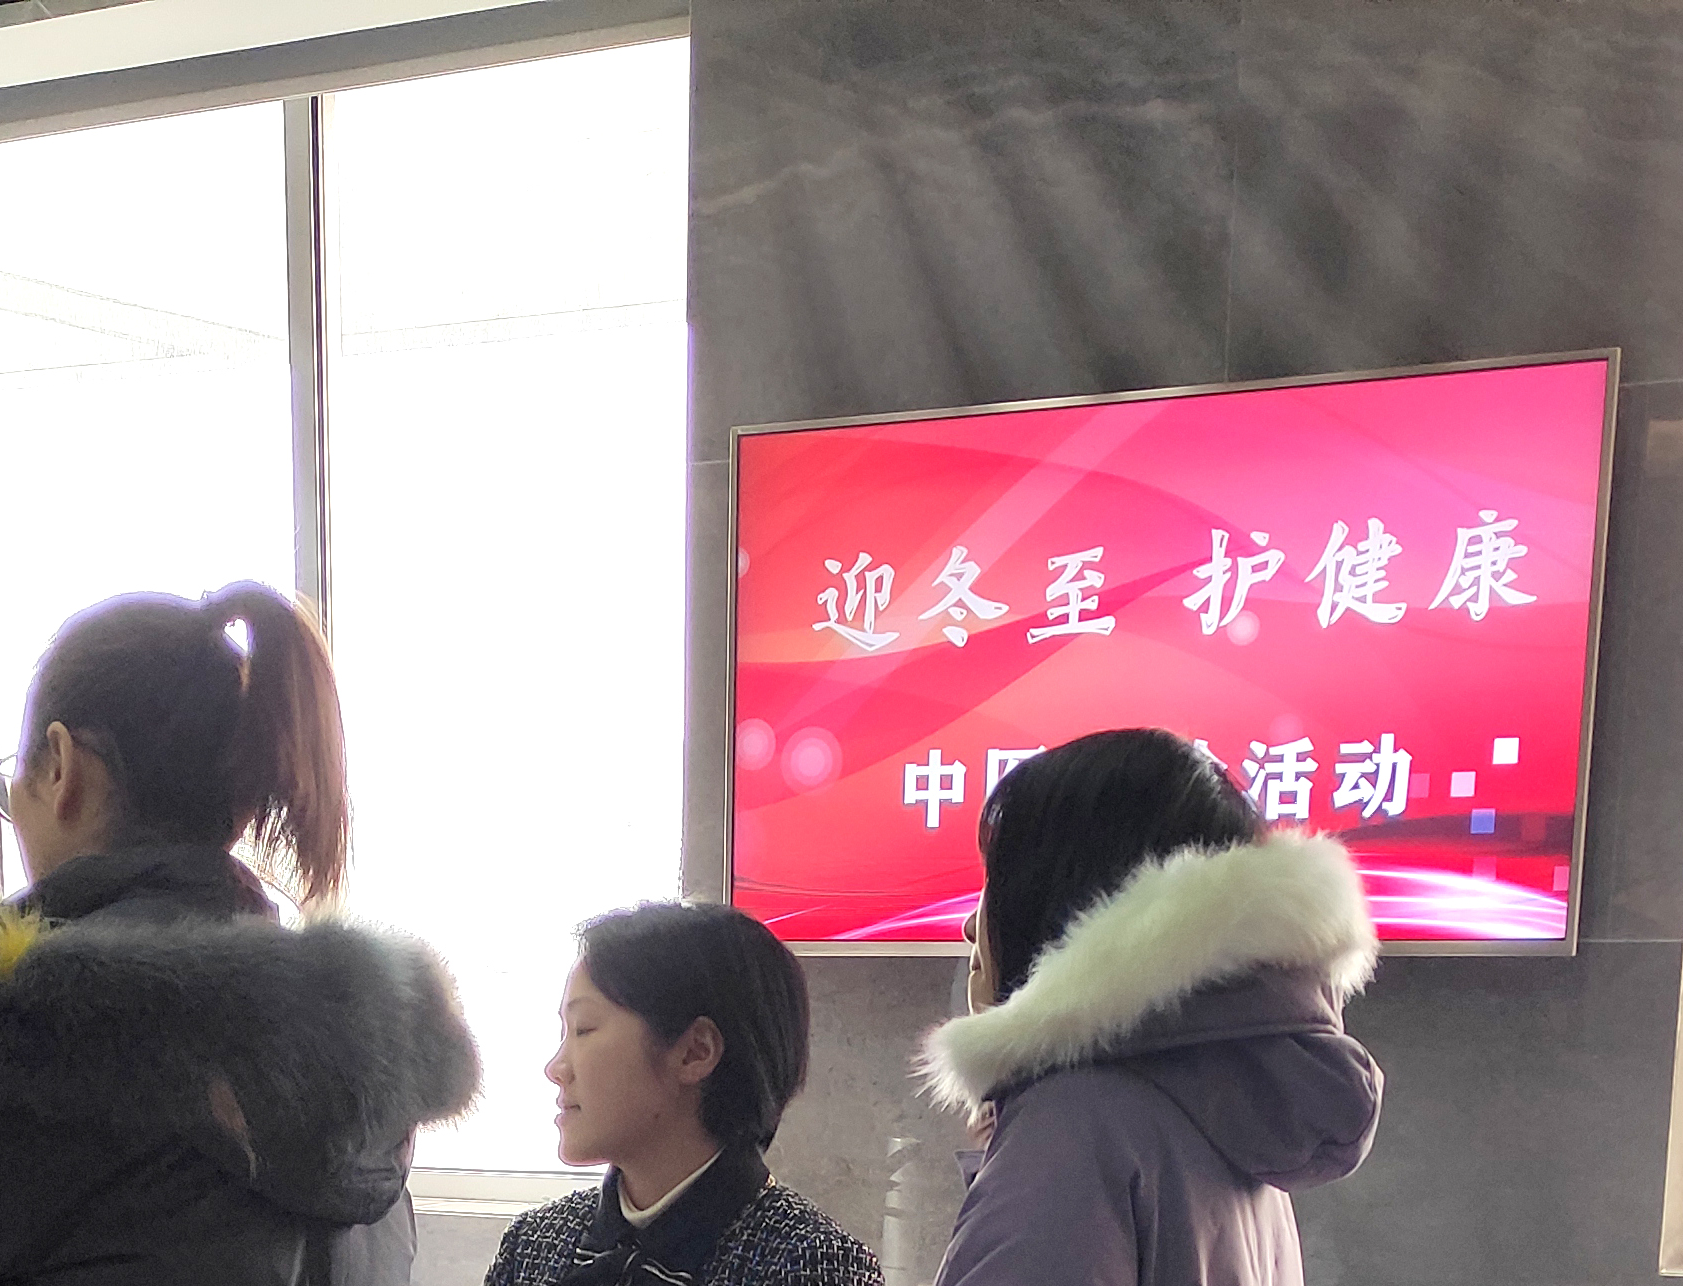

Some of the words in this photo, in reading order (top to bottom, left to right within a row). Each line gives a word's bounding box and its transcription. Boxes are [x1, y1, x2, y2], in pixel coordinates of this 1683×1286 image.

[811, 545, 1117, 652] 迎冬至
[1182, 508, 1538, 636] 护健康
